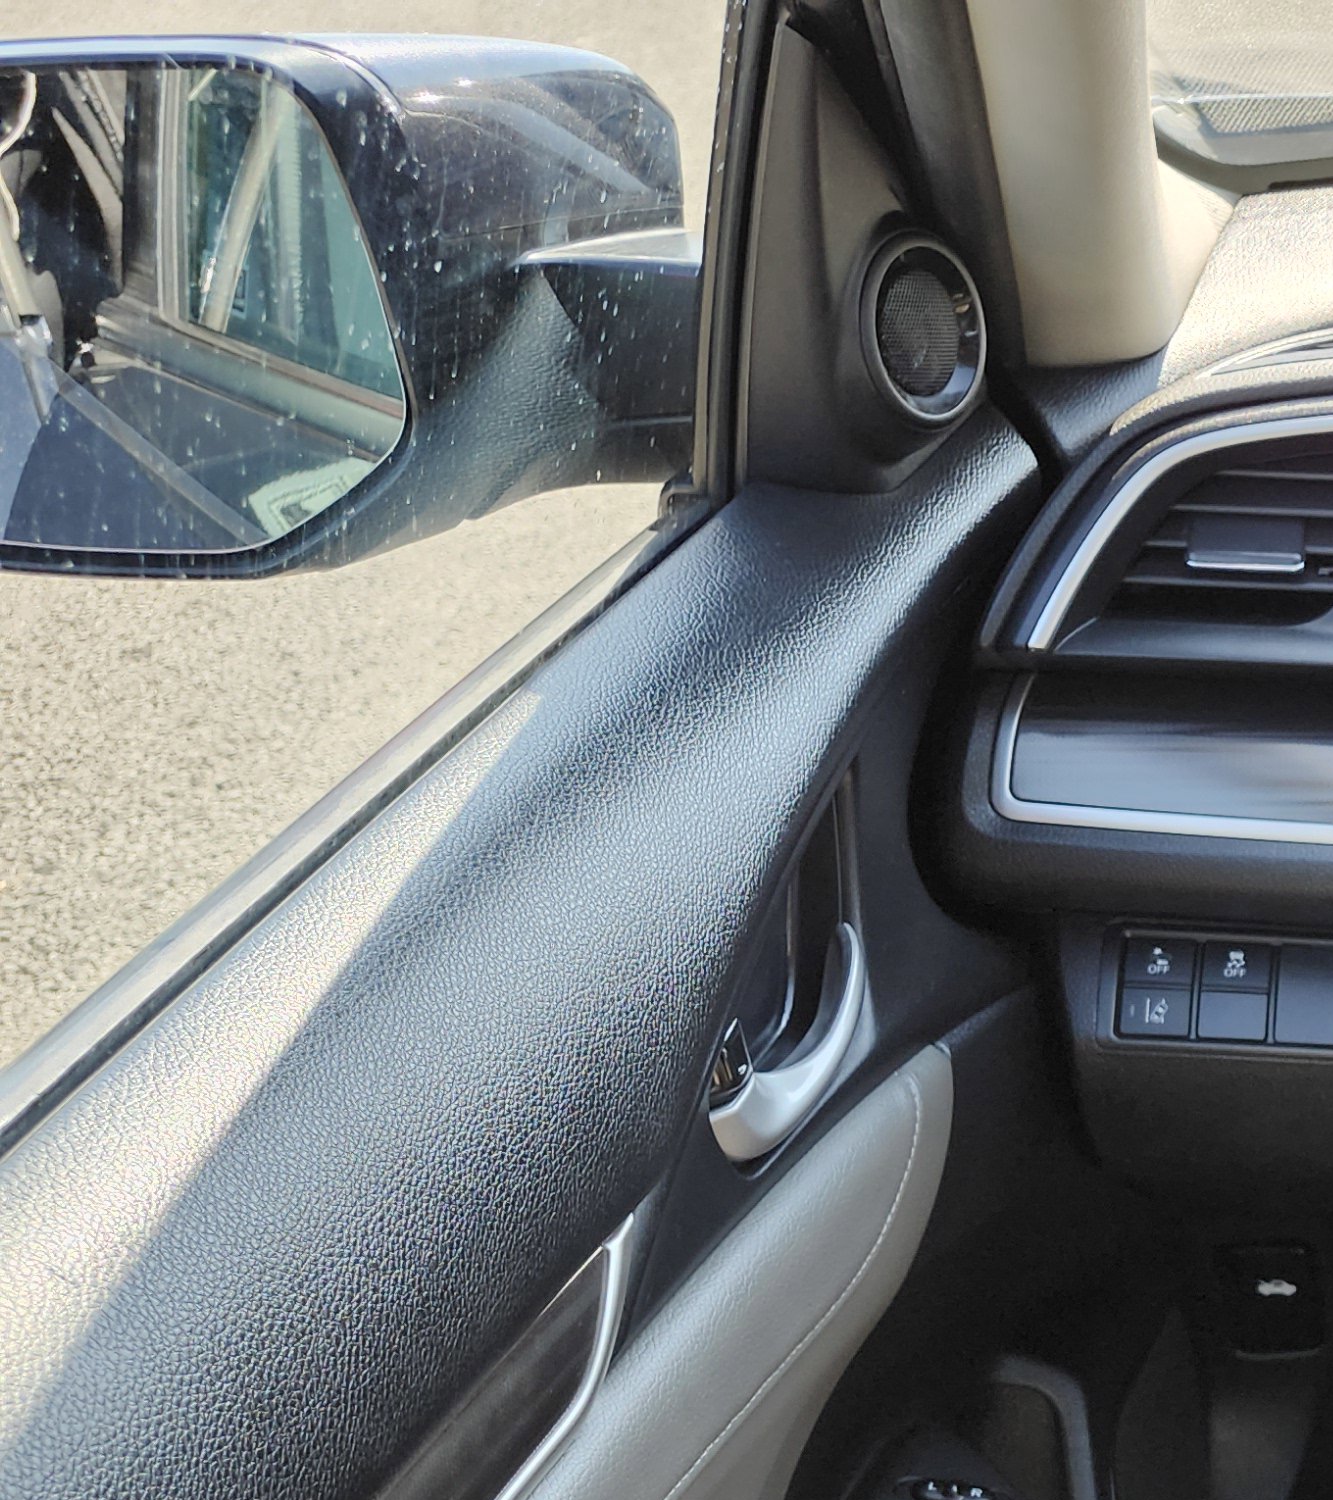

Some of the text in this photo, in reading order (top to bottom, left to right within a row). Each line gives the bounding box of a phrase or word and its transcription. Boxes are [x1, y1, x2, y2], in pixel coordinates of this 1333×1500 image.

[1147, 963, 1170, 975] OFF
[1223, 967, 1246, 978] OFF
[970, 1487, 983, 1498] R
